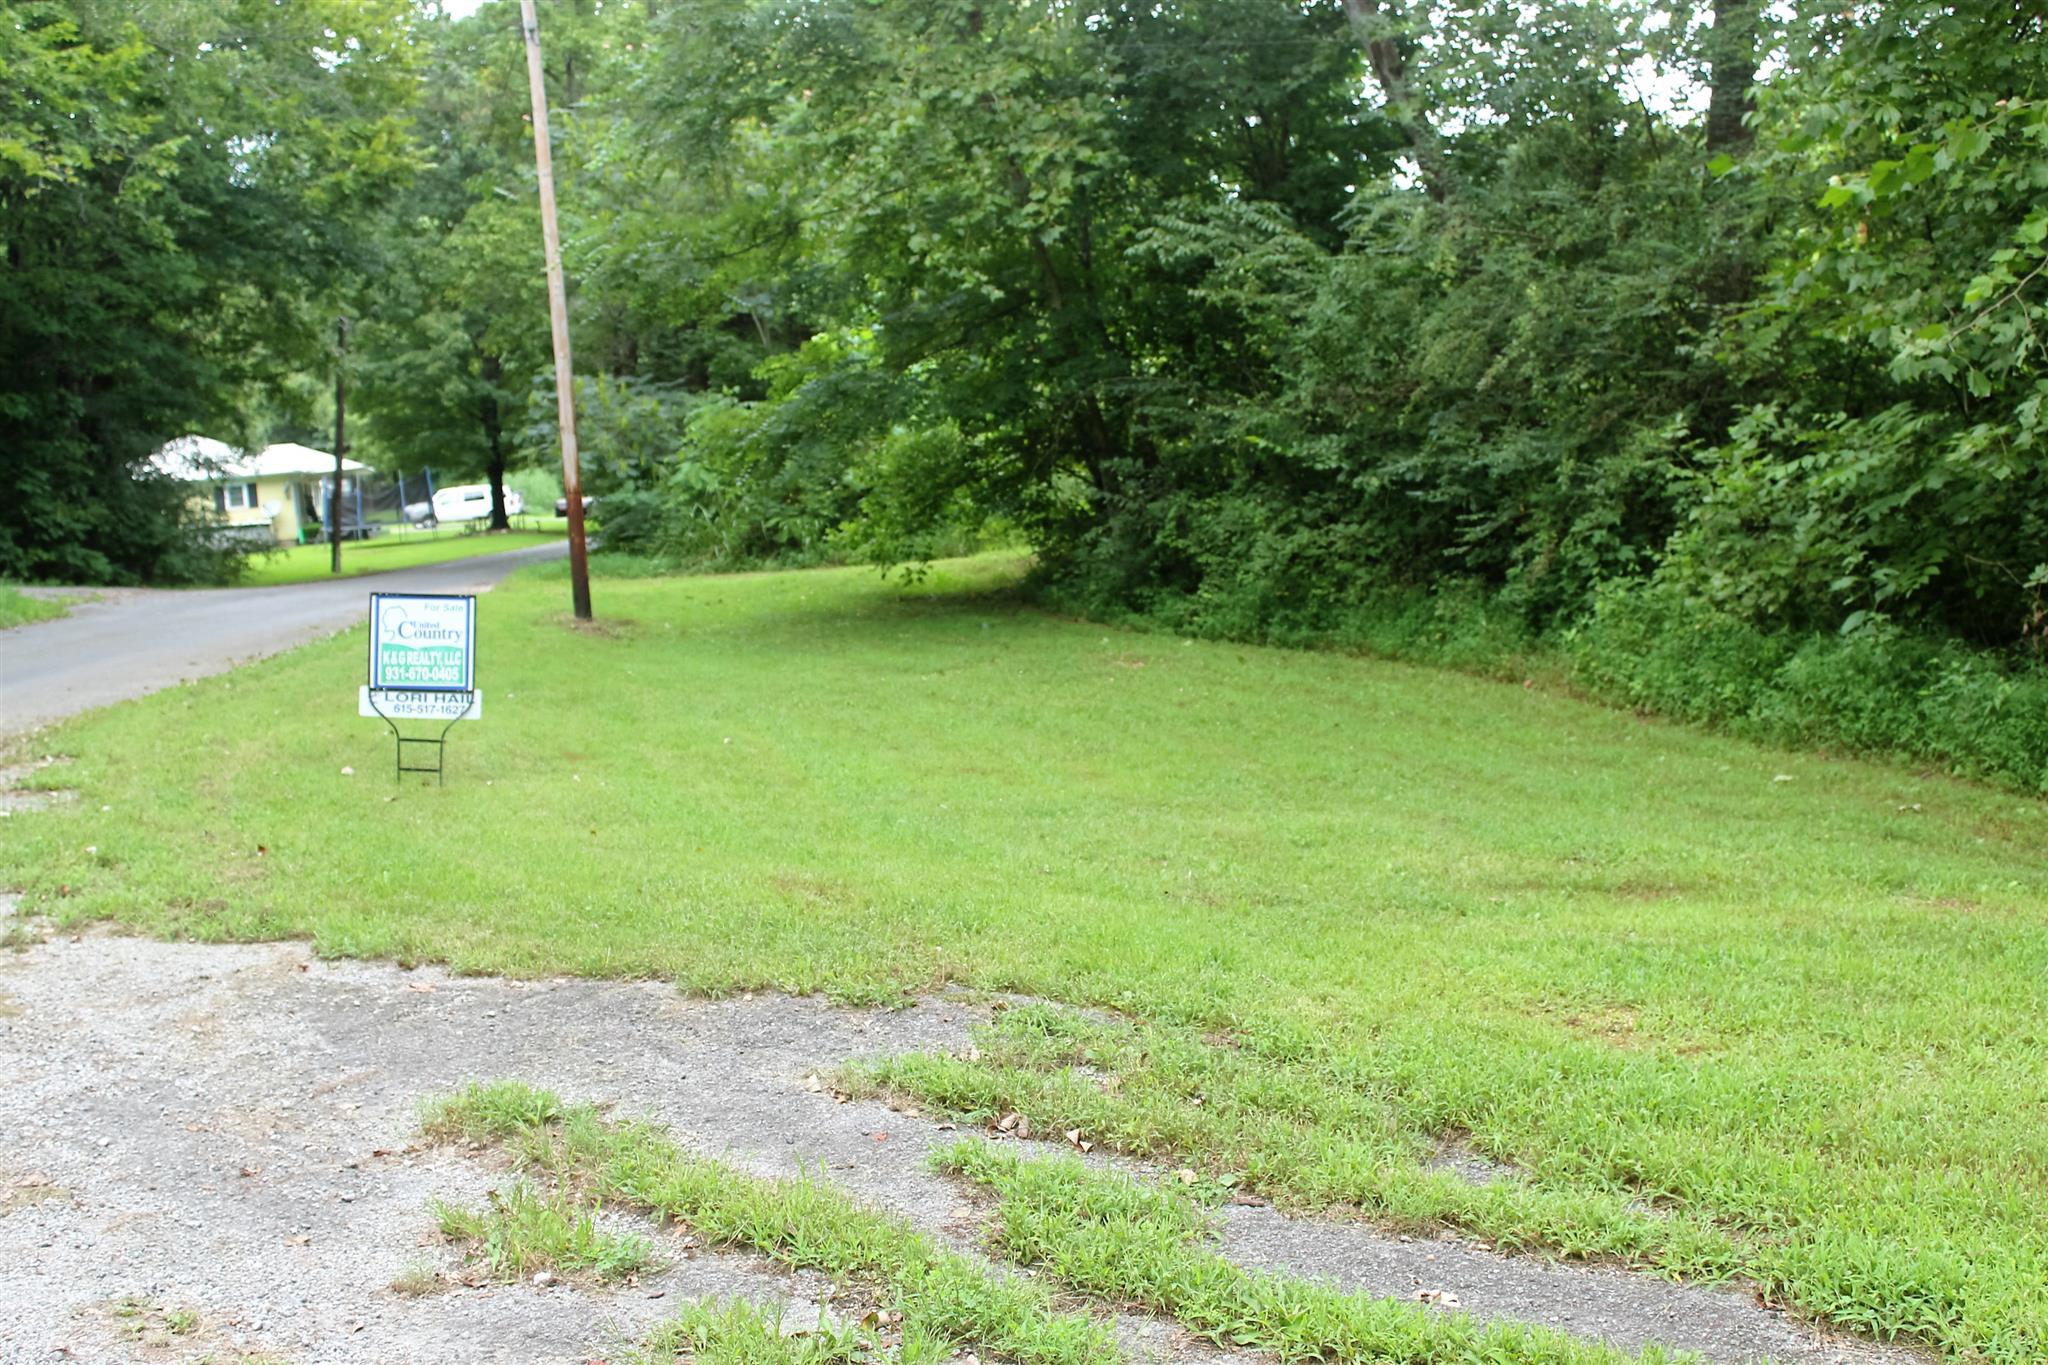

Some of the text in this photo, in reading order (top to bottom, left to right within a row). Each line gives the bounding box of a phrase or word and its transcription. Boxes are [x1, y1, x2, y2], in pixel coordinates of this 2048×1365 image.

[424, 603, 464, 612] For Sale
[398, 620, 463, 643] Country
[382, 651, 390, 665] K
[398, 651, 406, 665] G
[444, 651, 461, 665] LLC
[385, 692, 427, 703] LORI
[393, 703, 466, 715] 615-517-1627
